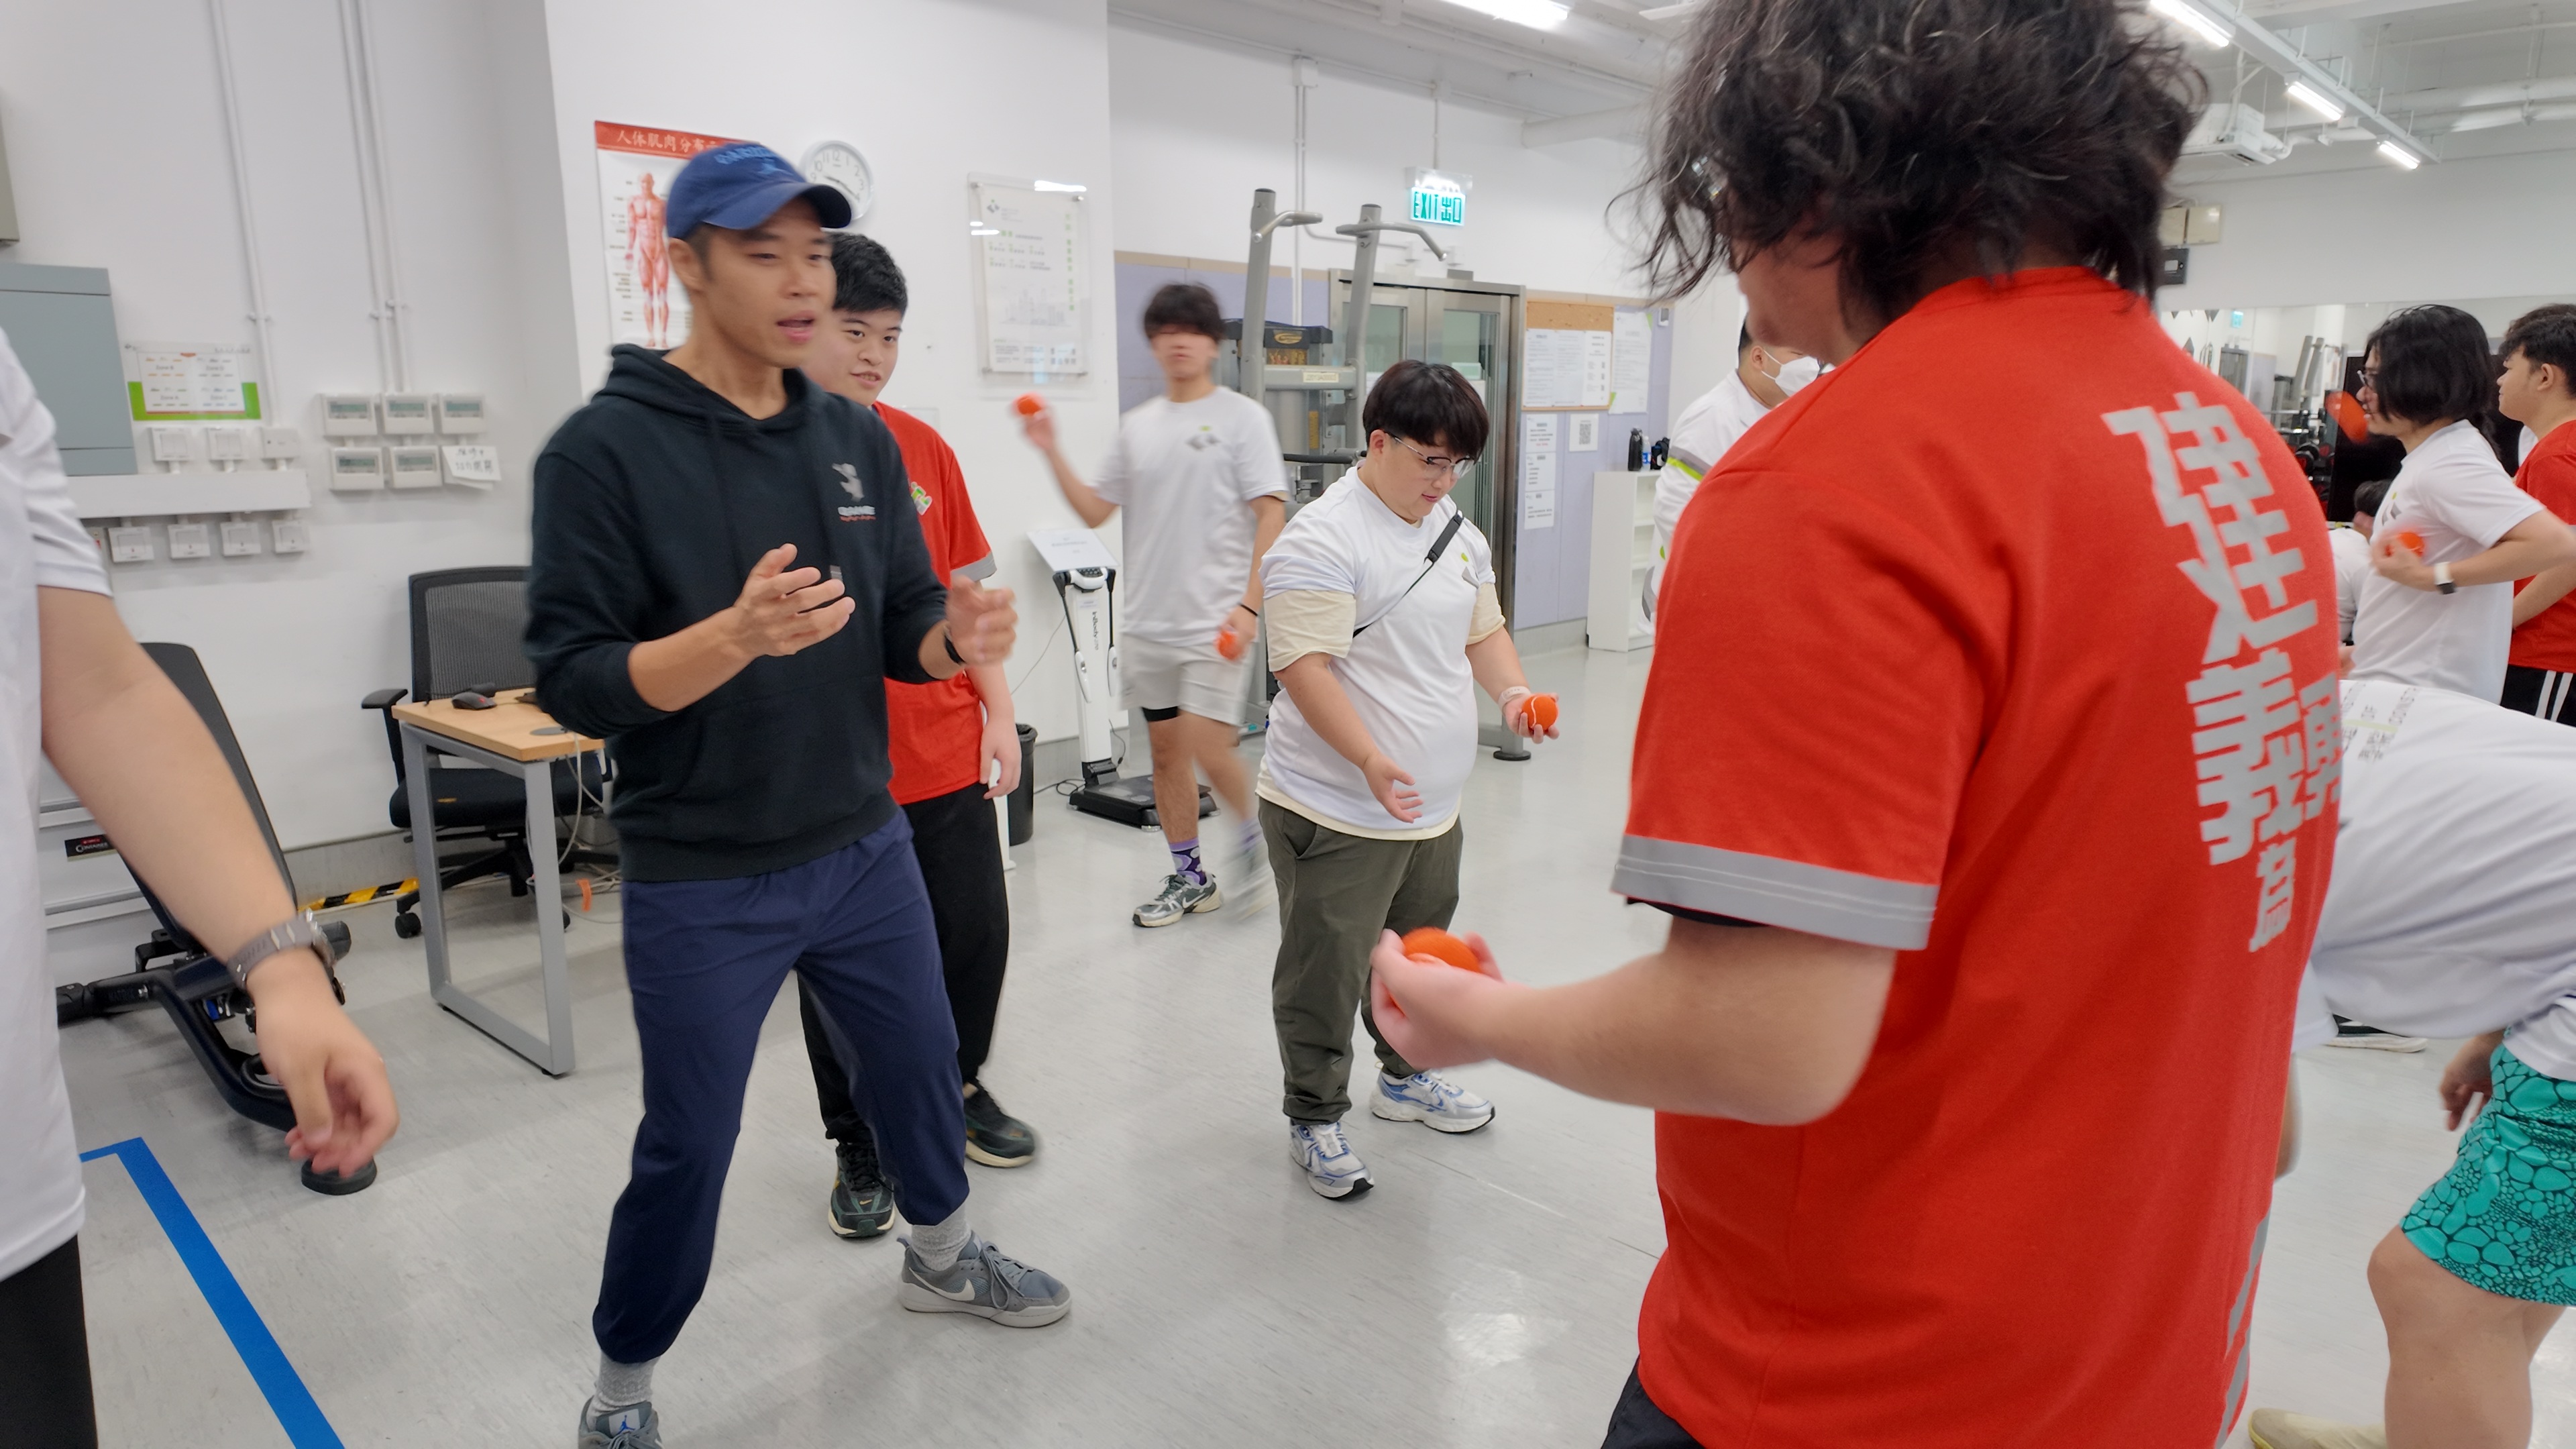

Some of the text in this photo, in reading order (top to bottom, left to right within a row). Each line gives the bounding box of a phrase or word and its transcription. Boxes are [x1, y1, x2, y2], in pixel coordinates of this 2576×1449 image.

[616, 130, 720, 153] 人体肌肉分布
[822, 151, 829, 164] 11
[833, 149, 840, 162] 12
[814, 160, 822, 172] 10
[853, 165, 860, 176] 2
[1413, 191, 1462, 223] EXIT 出口
